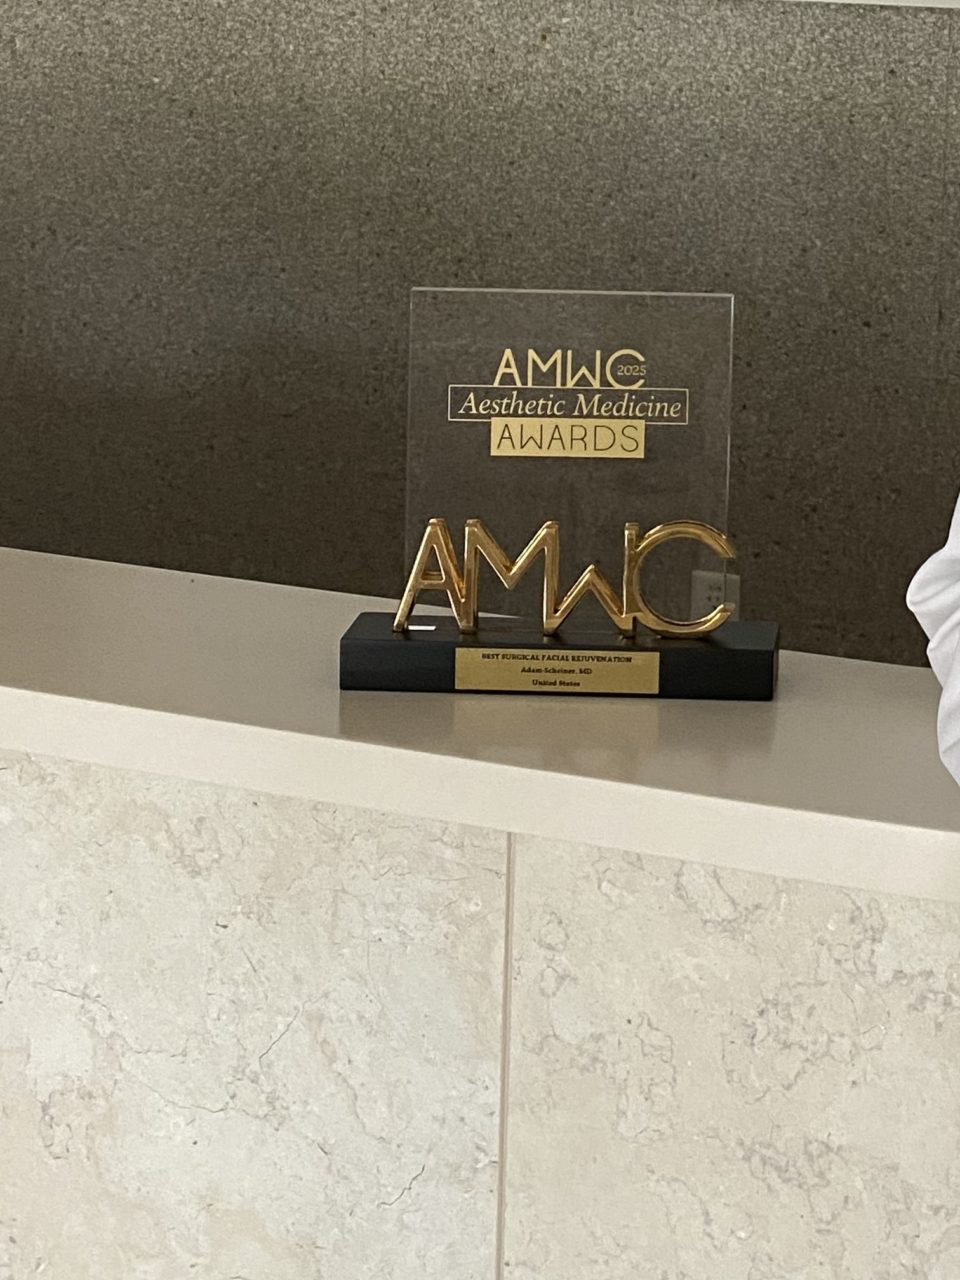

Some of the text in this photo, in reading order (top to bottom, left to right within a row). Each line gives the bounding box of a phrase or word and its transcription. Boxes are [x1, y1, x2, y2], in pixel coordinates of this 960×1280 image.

[493, 347, 647, 389] AMWC 2025
[457, 390, 682, 418] Aesthetic Medicine
[496, 423, 640, 453] AWARDS
[392, 517, 736, 639] AMWC
[481, 652, 633, 663] BEST SURGICAL FACIAL REJUVENATION
[531, 679, 557, 687] United
